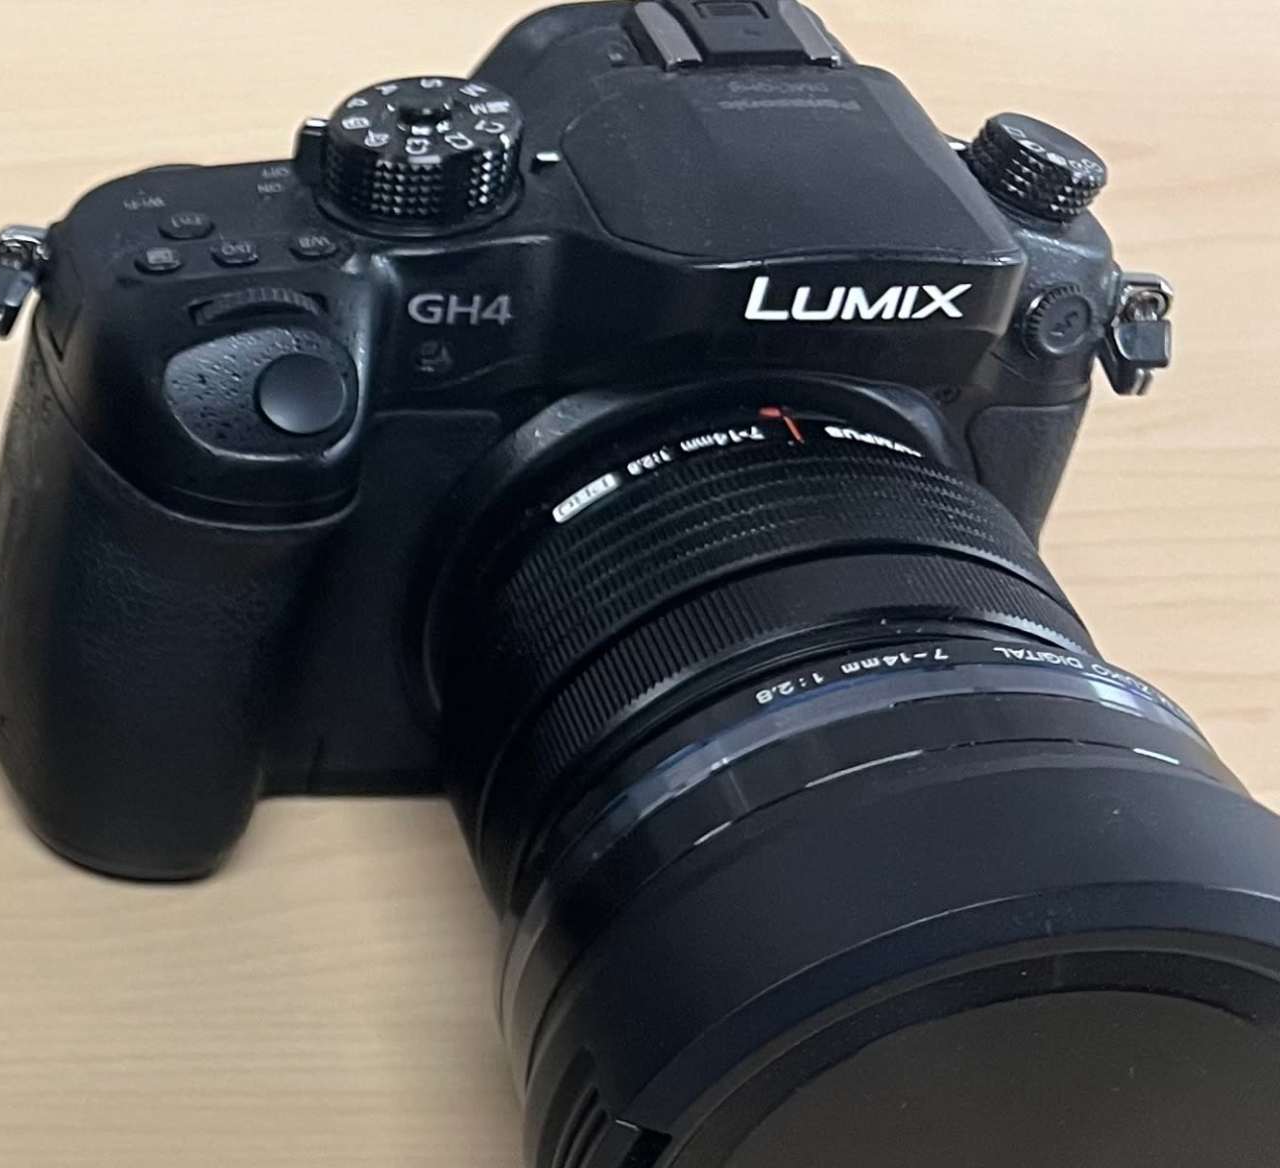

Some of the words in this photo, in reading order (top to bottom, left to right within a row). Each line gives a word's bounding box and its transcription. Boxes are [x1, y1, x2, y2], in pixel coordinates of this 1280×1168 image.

[408, 295, 514, 326] GH4
[744, 276, 972, 321] LUMIX
[840, 647, 950, 675] 7-14mm
[992, 646, 1084, 670] DIGITAL
